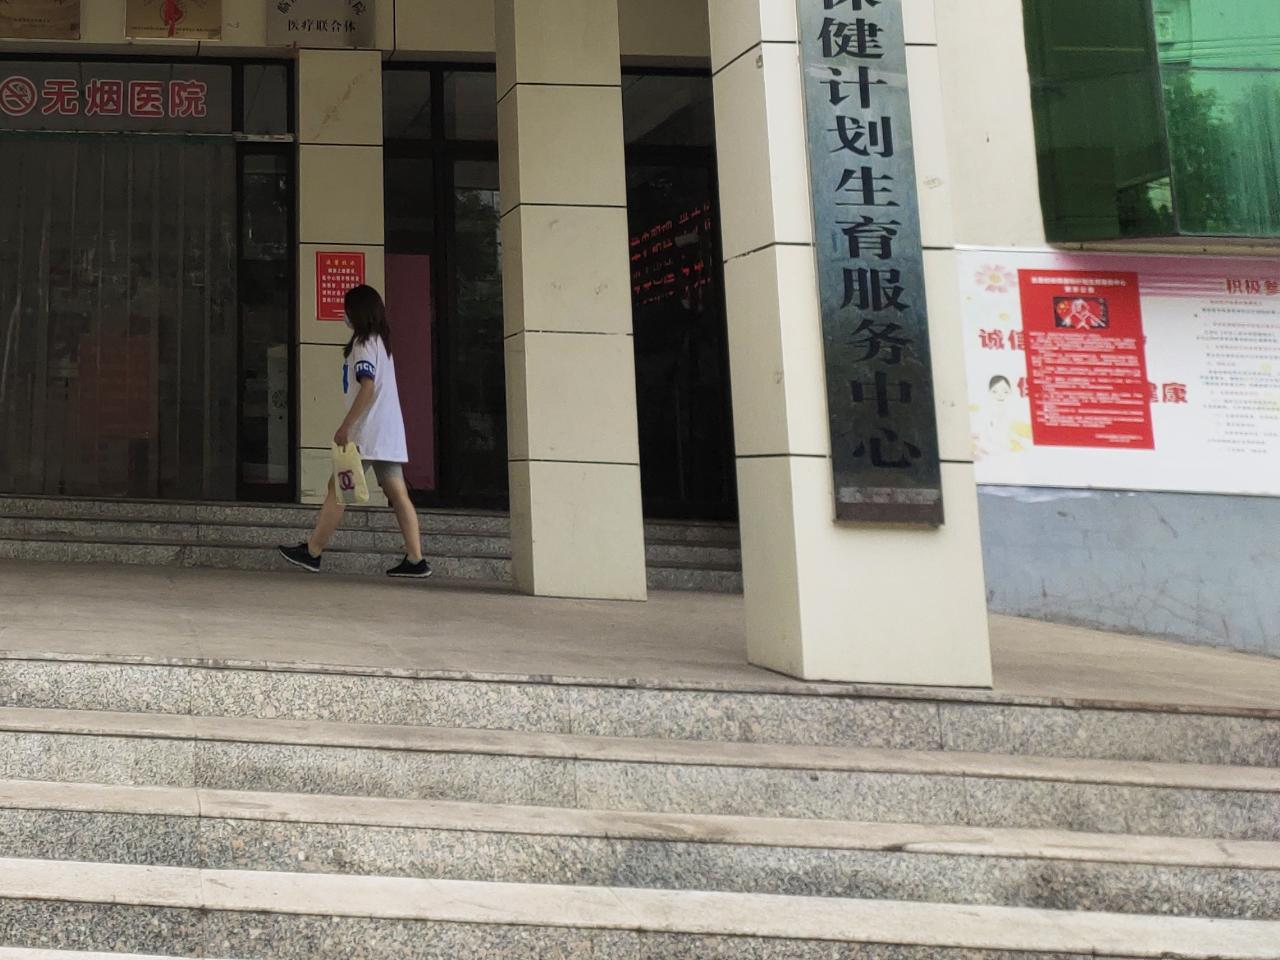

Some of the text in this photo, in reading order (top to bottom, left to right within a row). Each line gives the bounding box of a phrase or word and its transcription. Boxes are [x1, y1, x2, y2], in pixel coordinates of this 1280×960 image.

[287, 19, 356, 33] 医疗联合体
[41, 78, 208, 118] 无烟医院
